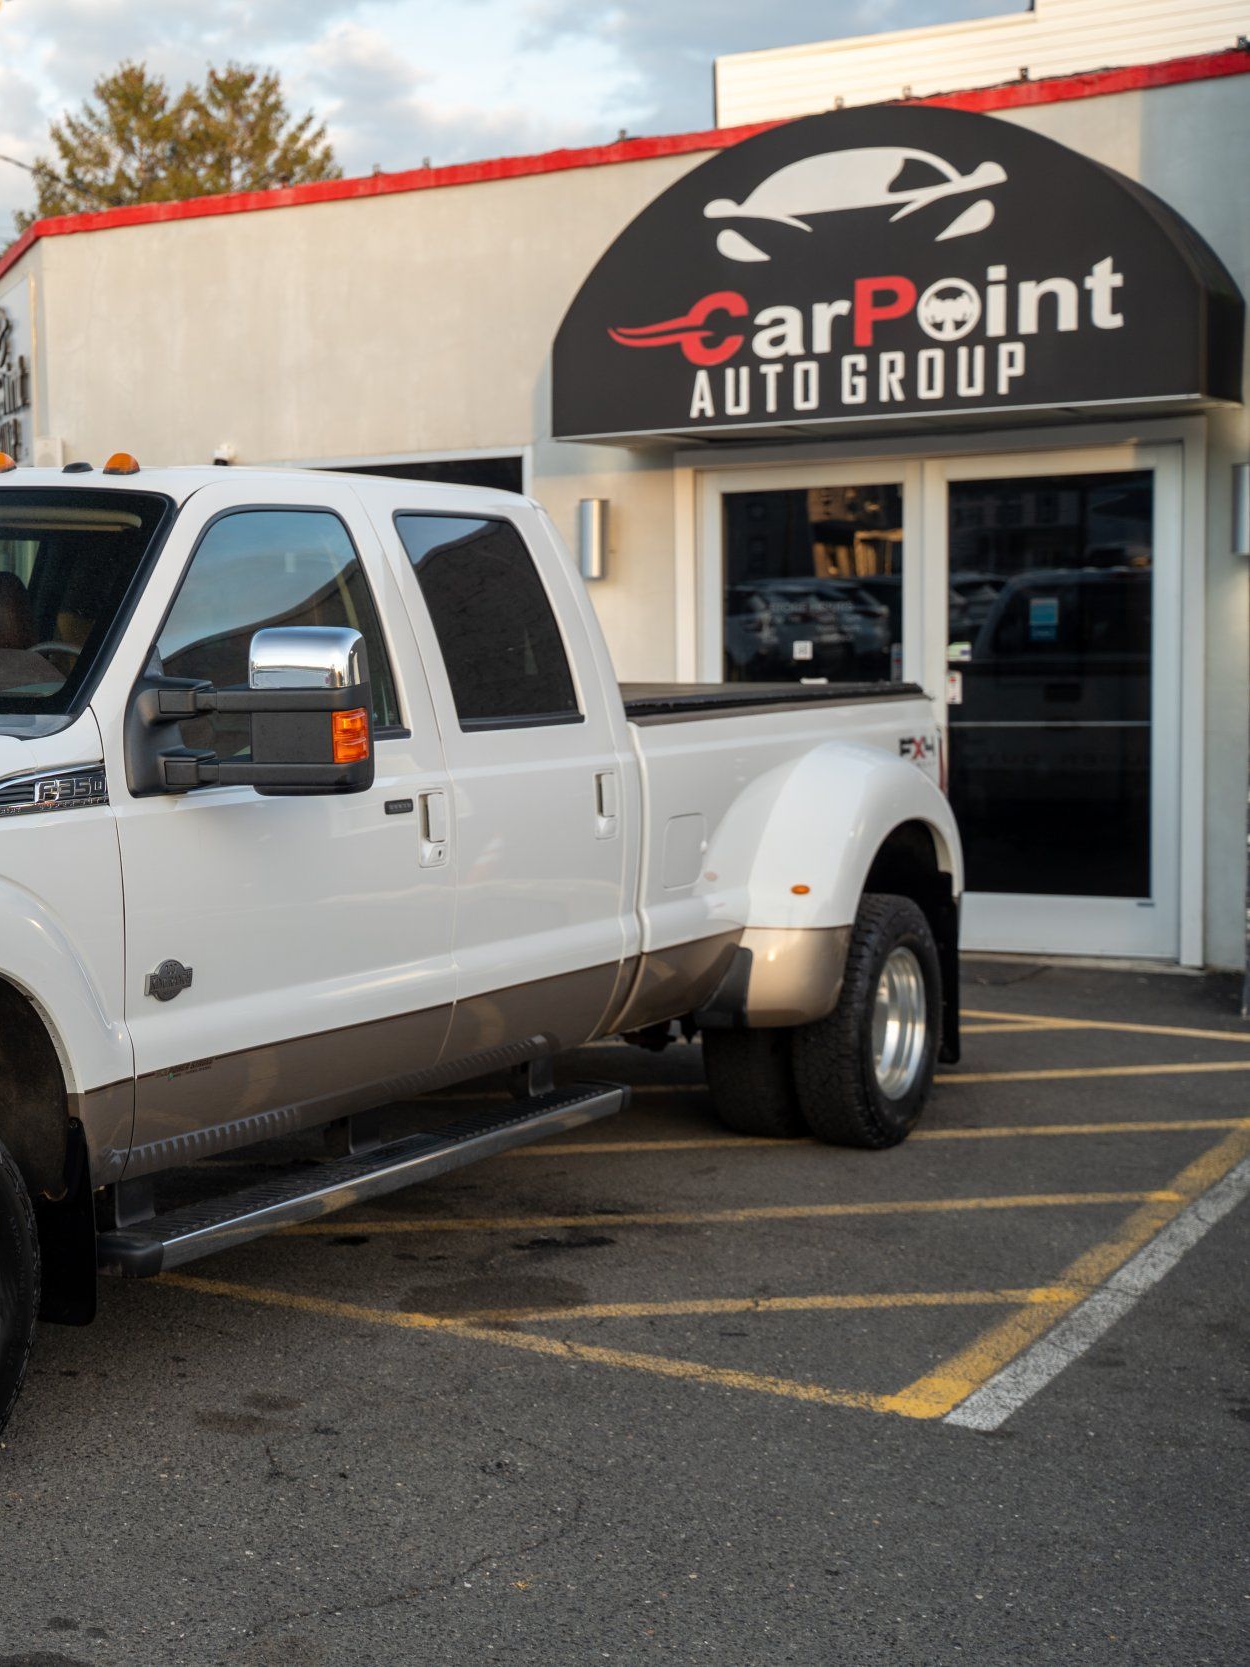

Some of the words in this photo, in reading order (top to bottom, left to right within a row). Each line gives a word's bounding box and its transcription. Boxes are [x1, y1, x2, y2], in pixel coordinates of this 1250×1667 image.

[607, 256, 1125, 367] CarPoint
[689, 360, 819, 419] AUTO
[841, 341, 1026, 405] GROUP
[898, 735, 935, 758] FX4
